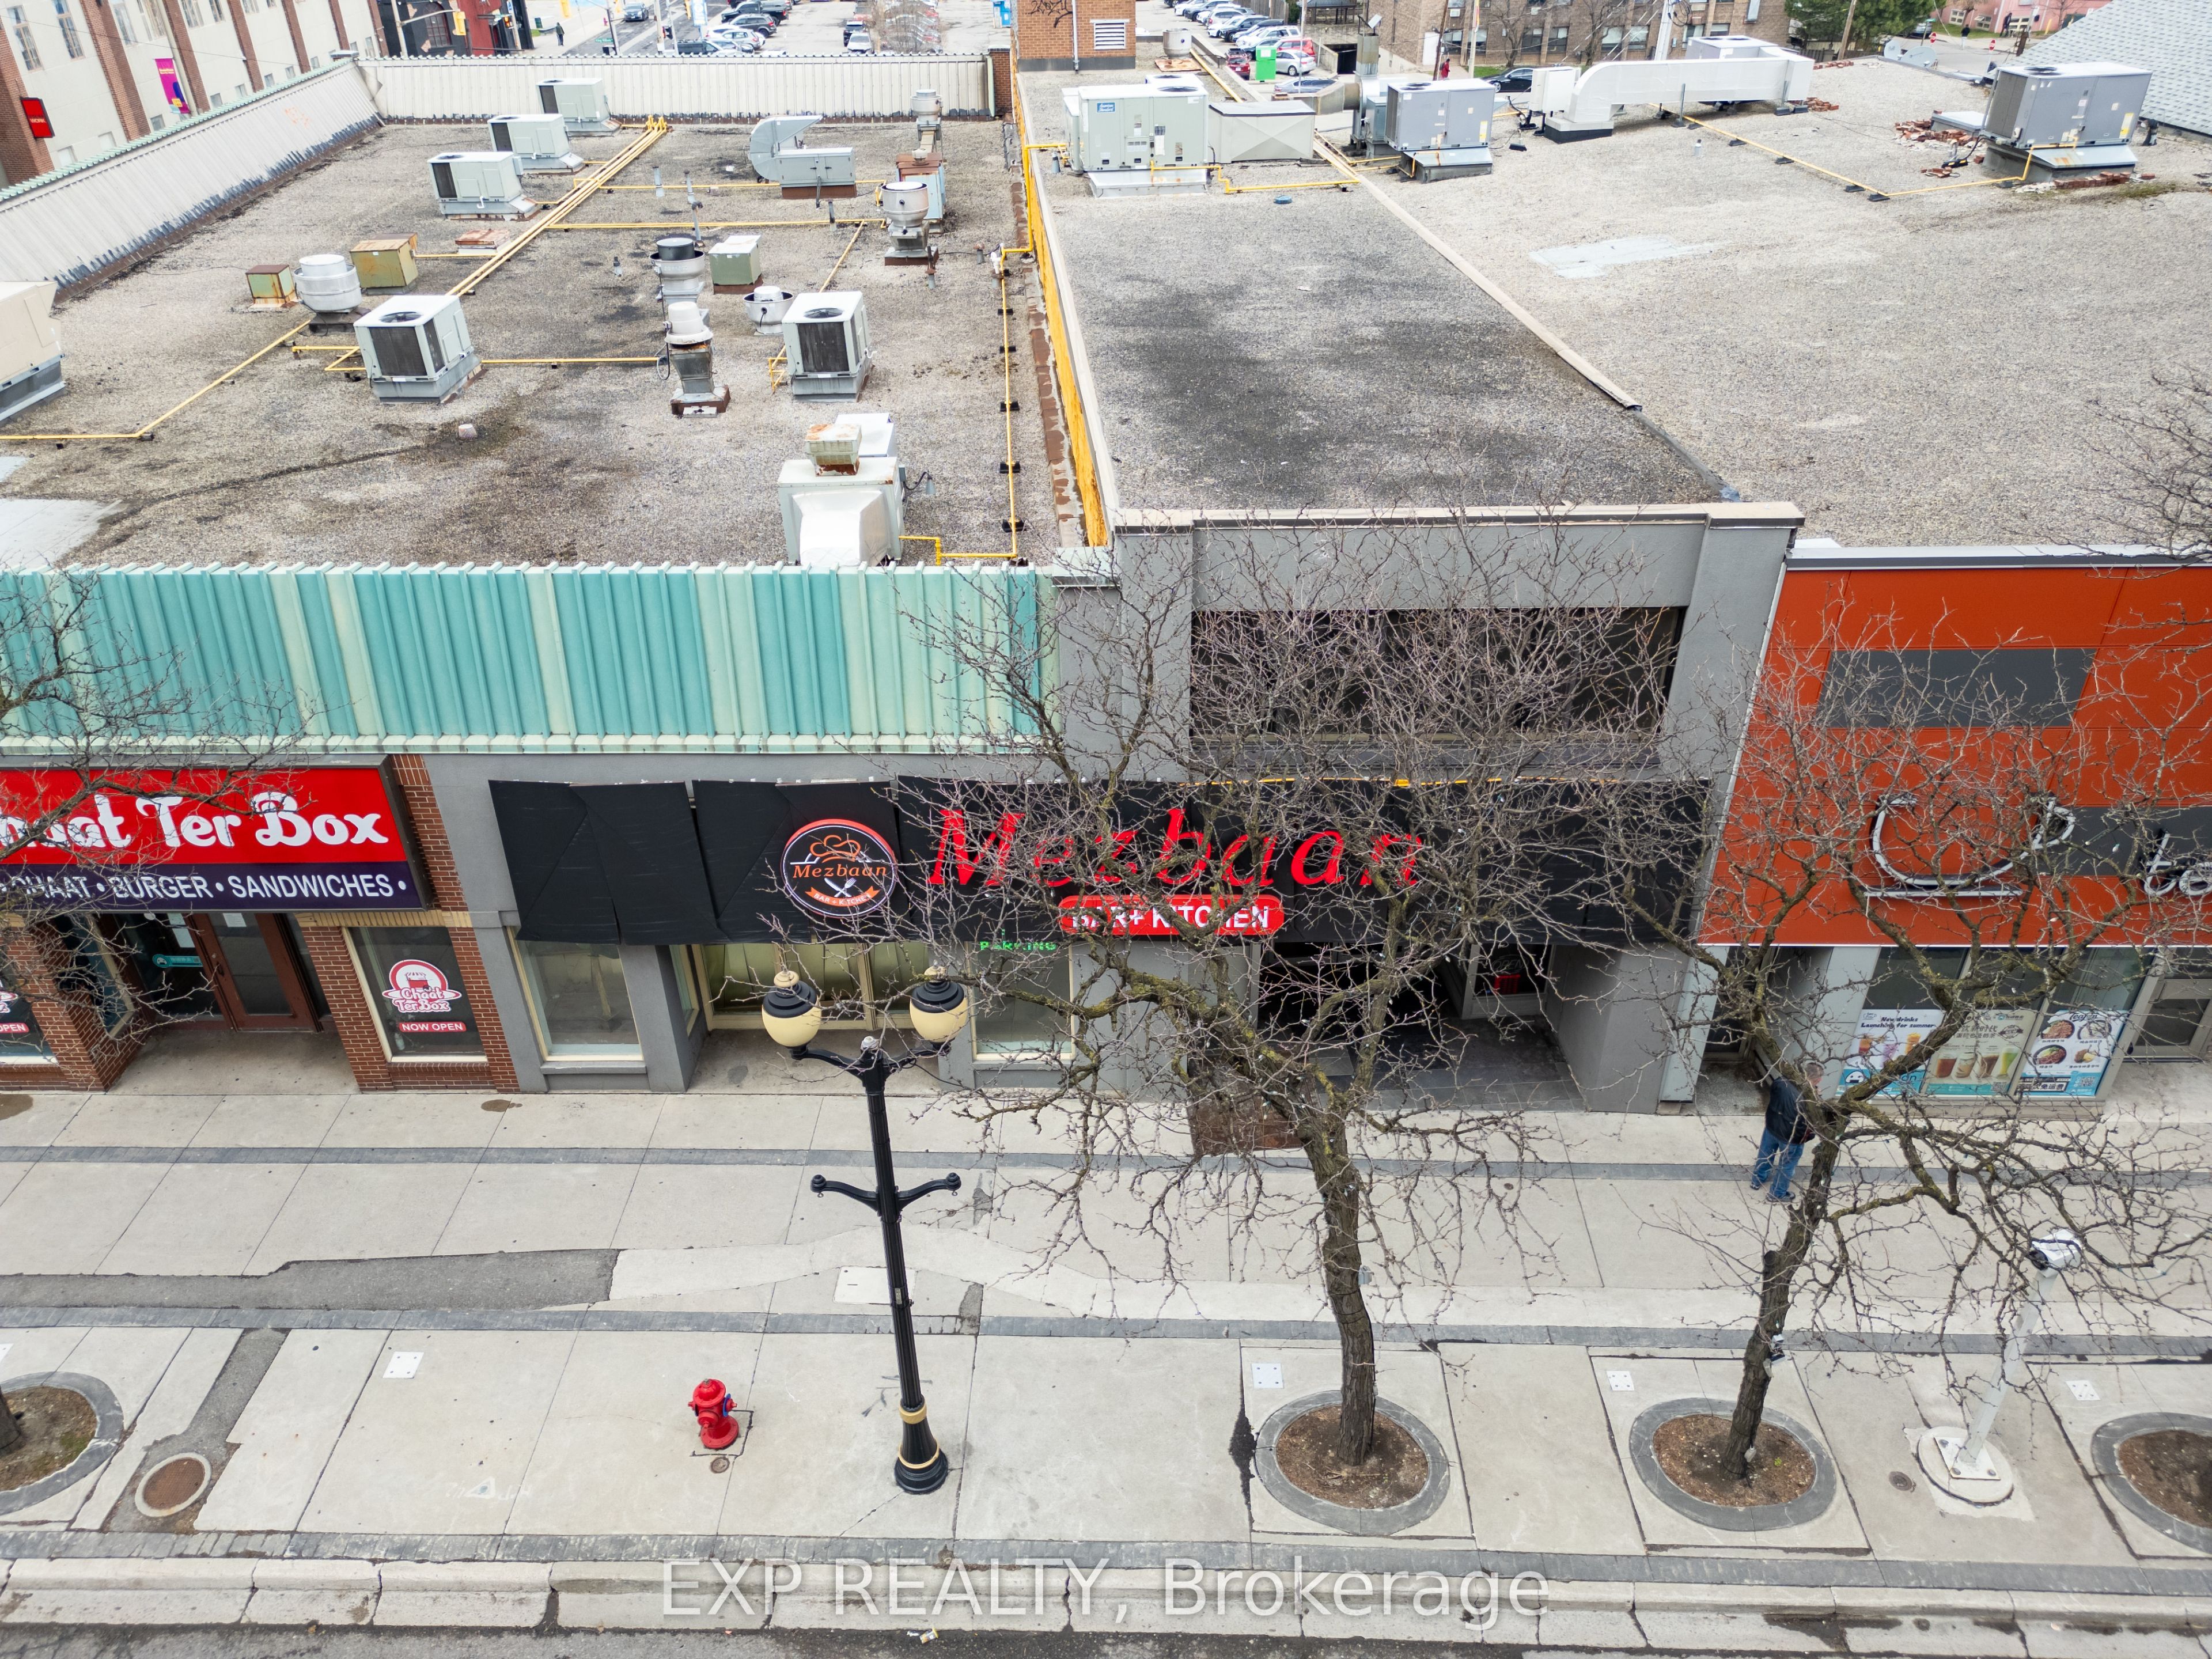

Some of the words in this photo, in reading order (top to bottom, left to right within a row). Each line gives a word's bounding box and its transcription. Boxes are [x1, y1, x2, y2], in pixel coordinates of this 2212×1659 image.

[135, 796, 242, 847] Ter
[251, 791, 389, 847] Box
[793, 864, 887, 878] Mezbaan
[108, 876, 214, 898] BURGER
[229, 874, 394, 898] SANDWICHES
[813, 893, 830, 903] BAR
[1072, 906, 1127, 928] BR
[1152, 905, 1269, 928] KTCEN
[401, 987, 445, 999] Chaat
[395, 999, 418, 1011] Ter
[419, 999, 450, 1011] Box
